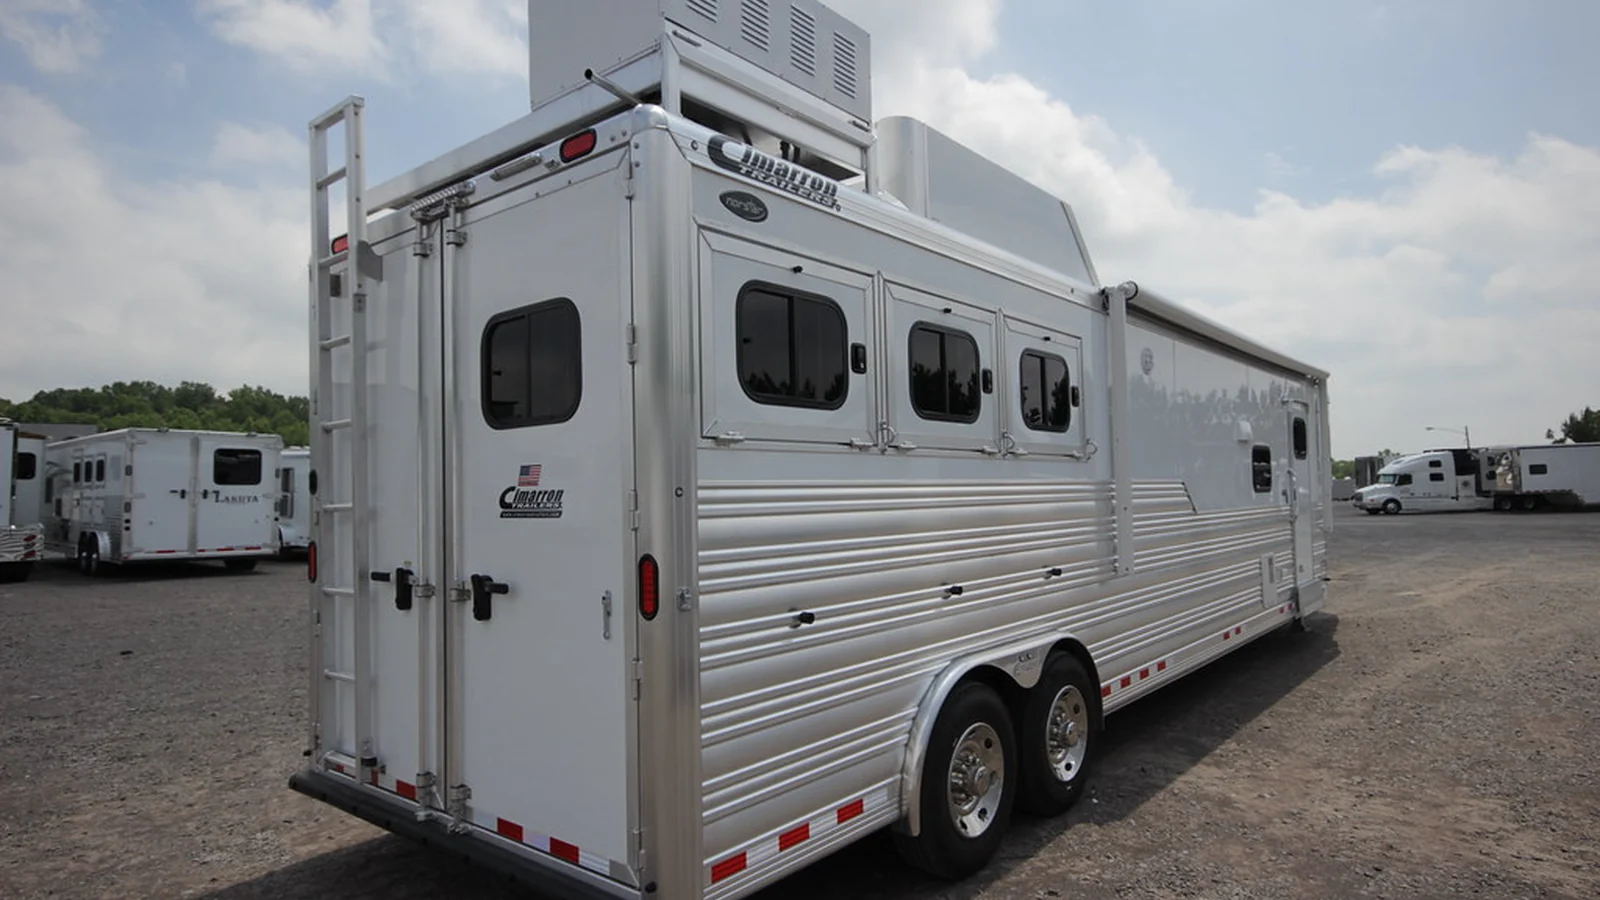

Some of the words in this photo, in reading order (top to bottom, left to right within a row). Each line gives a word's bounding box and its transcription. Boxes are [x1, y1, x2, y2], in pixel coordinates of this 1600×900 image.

[707, 134, 838, 197] Cimarron
[738, 164, 838, 209] TRAILERS
[499, 486, 564, 509] Cimarron
